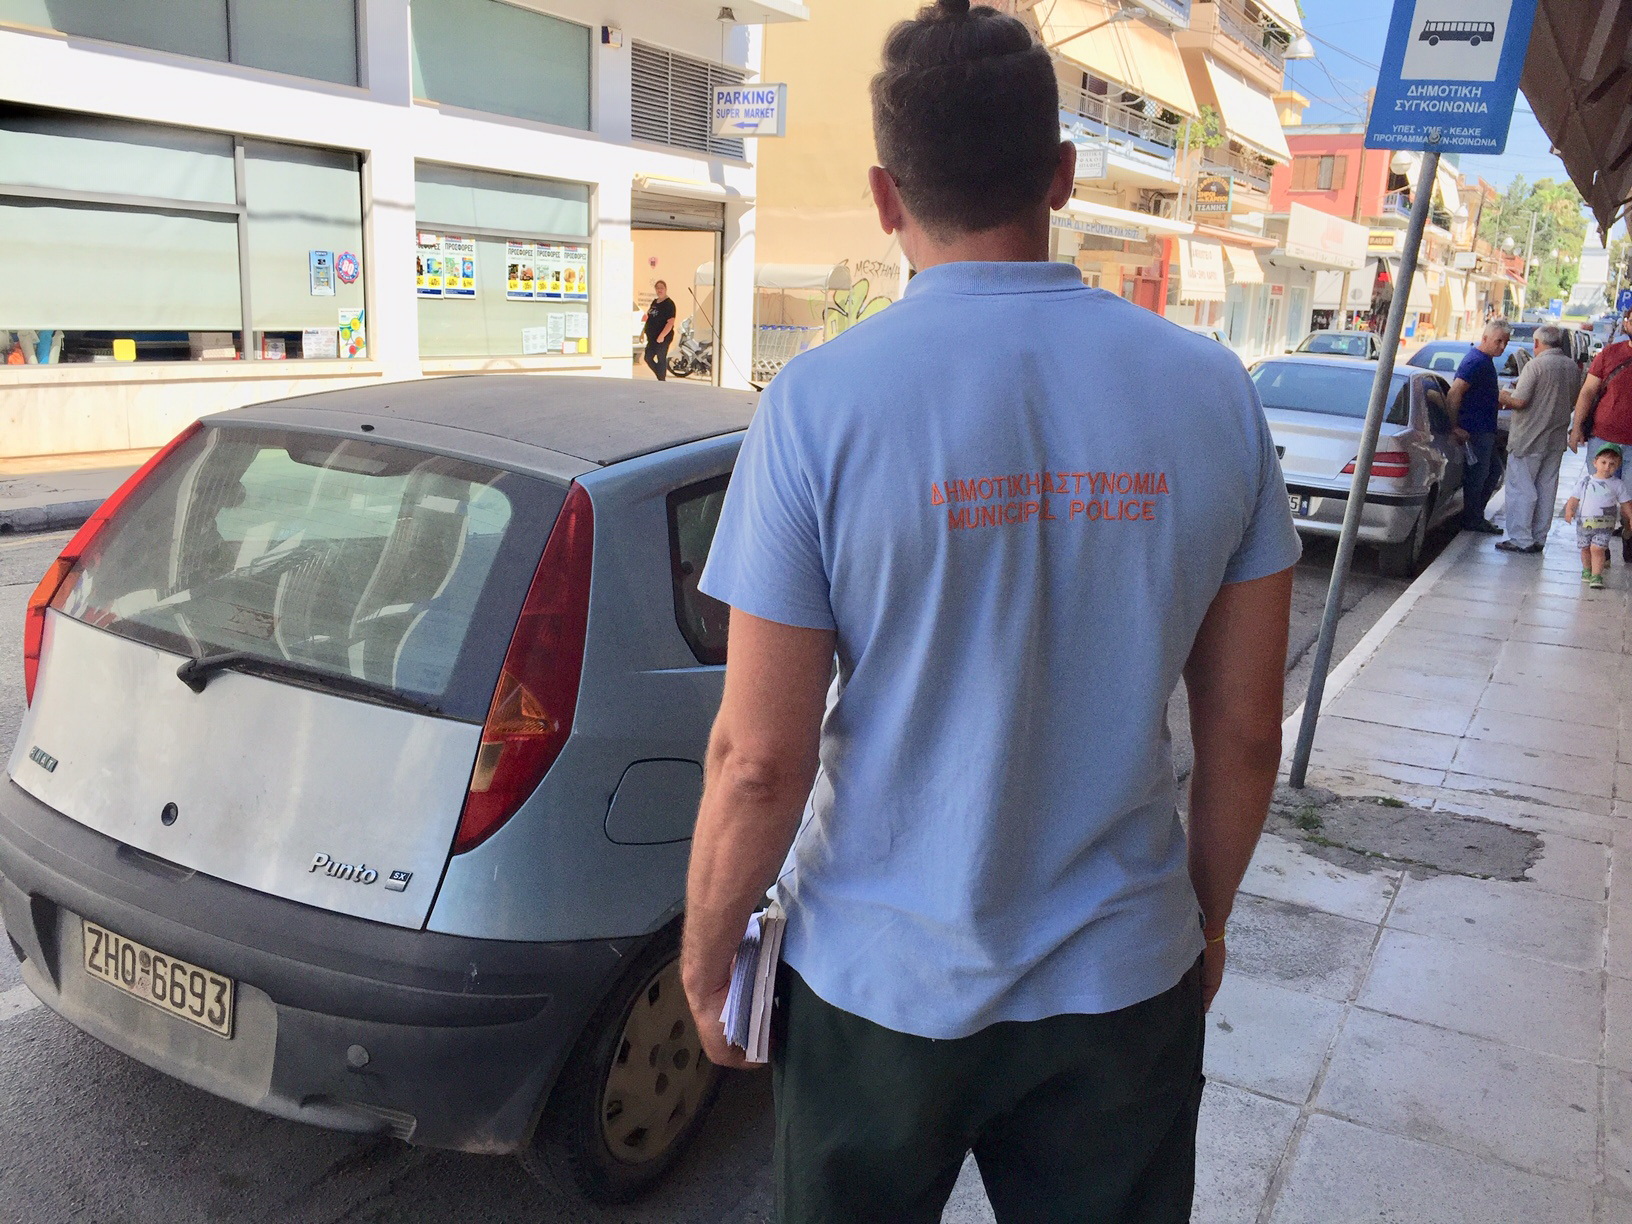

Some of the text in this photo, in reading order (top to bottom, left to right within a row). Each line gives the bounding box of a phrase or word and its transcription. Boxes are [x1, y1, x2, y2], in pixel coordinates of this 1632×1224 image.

[717, 90, 775, 105] PARKING
[1407, 84, 1482, 98] ΔΗΜΟΤΙΚΗ
[716, 108, 775, 118] SUPER MARKET
[1394, 99, 1489, 114] ΣΥΓΚΟΙΝΩΝΙΑ
[1392, 124, 1416, 134] ΥΠΕΣ
[1449, 127, 1482, 137] ΚΕΔΚΕ
[1373, 133, 1429, 144] ΠΡΟΓΡΑΜΜΑ
[947, 498, 1155, 530] MUNICIPL POLICE
[309, 852, 406, 885] Punto SX
